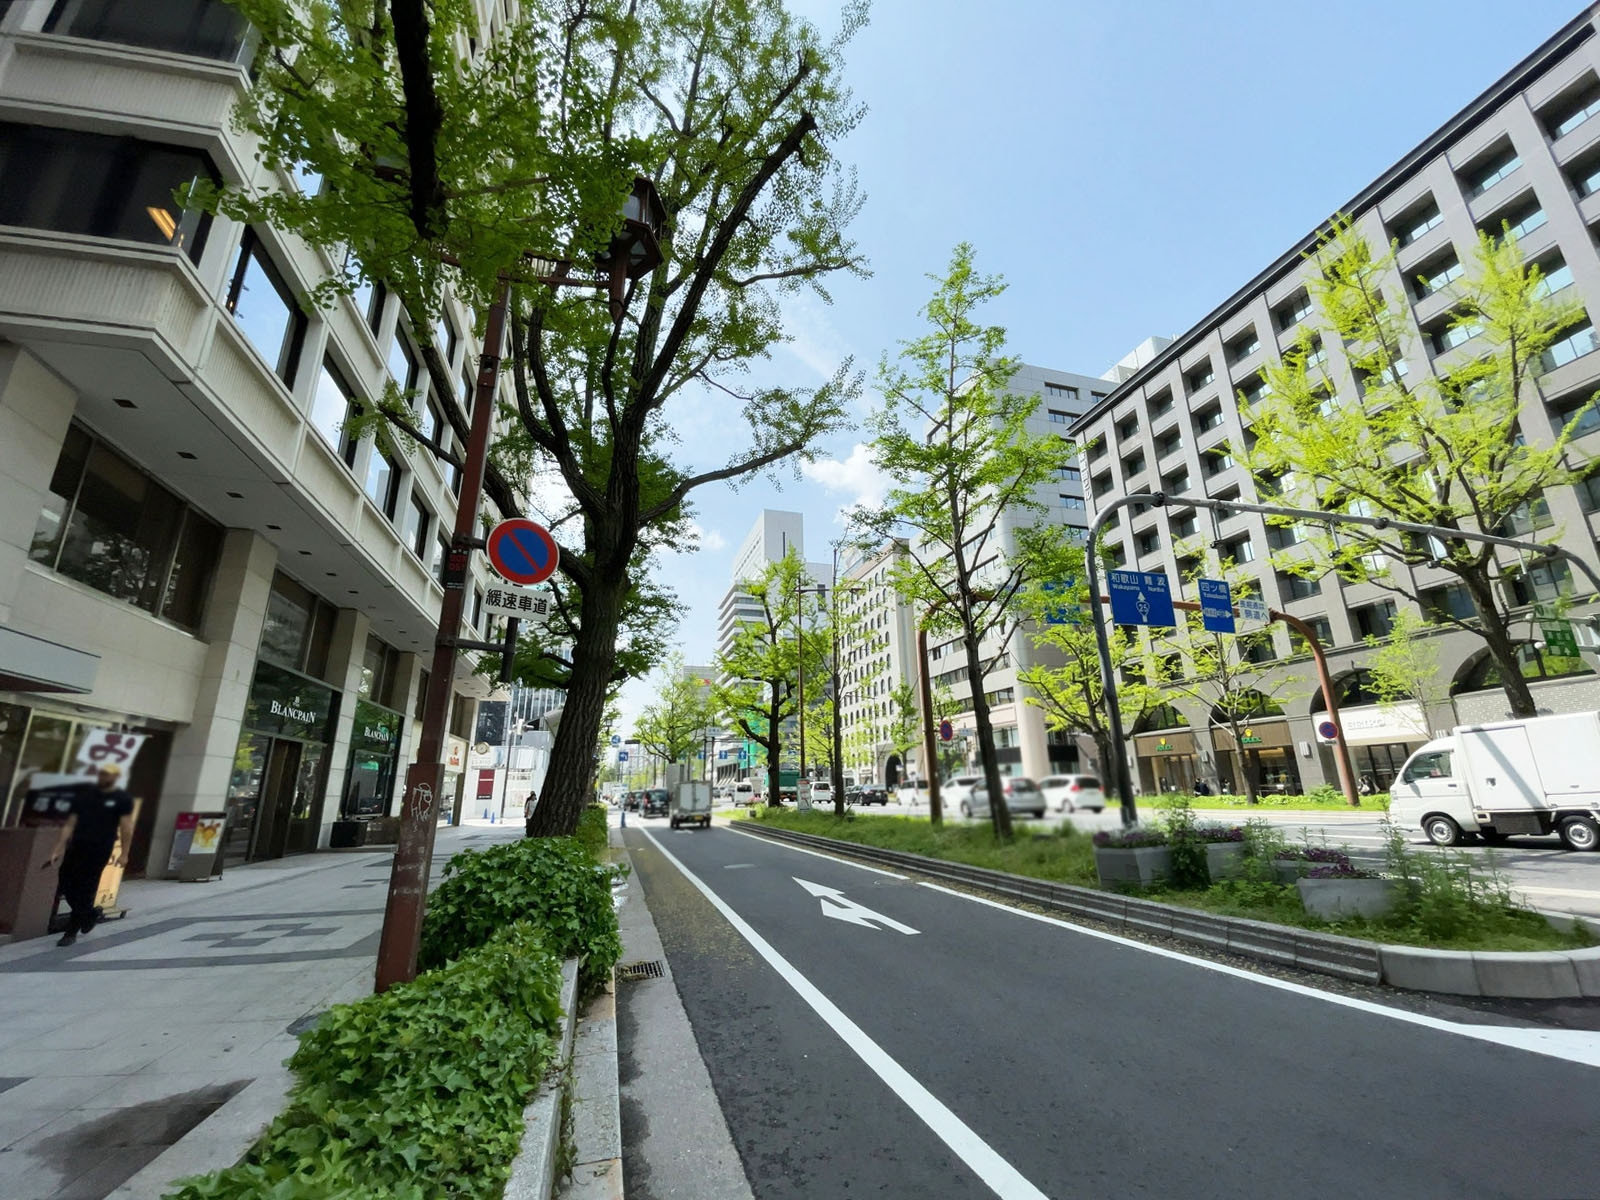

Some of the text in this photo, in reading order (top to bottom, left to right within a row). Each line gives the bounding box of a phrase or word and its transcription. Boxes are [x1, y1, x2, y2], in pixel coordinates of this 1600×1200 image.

[1111, 572, 1139, 585] 和歌山
[485, 588, 550, 615] 緩速車道
[270, 700, 317, 724] BLANCPAIN
[364, 726, 389, 741] BLANCPAIN
